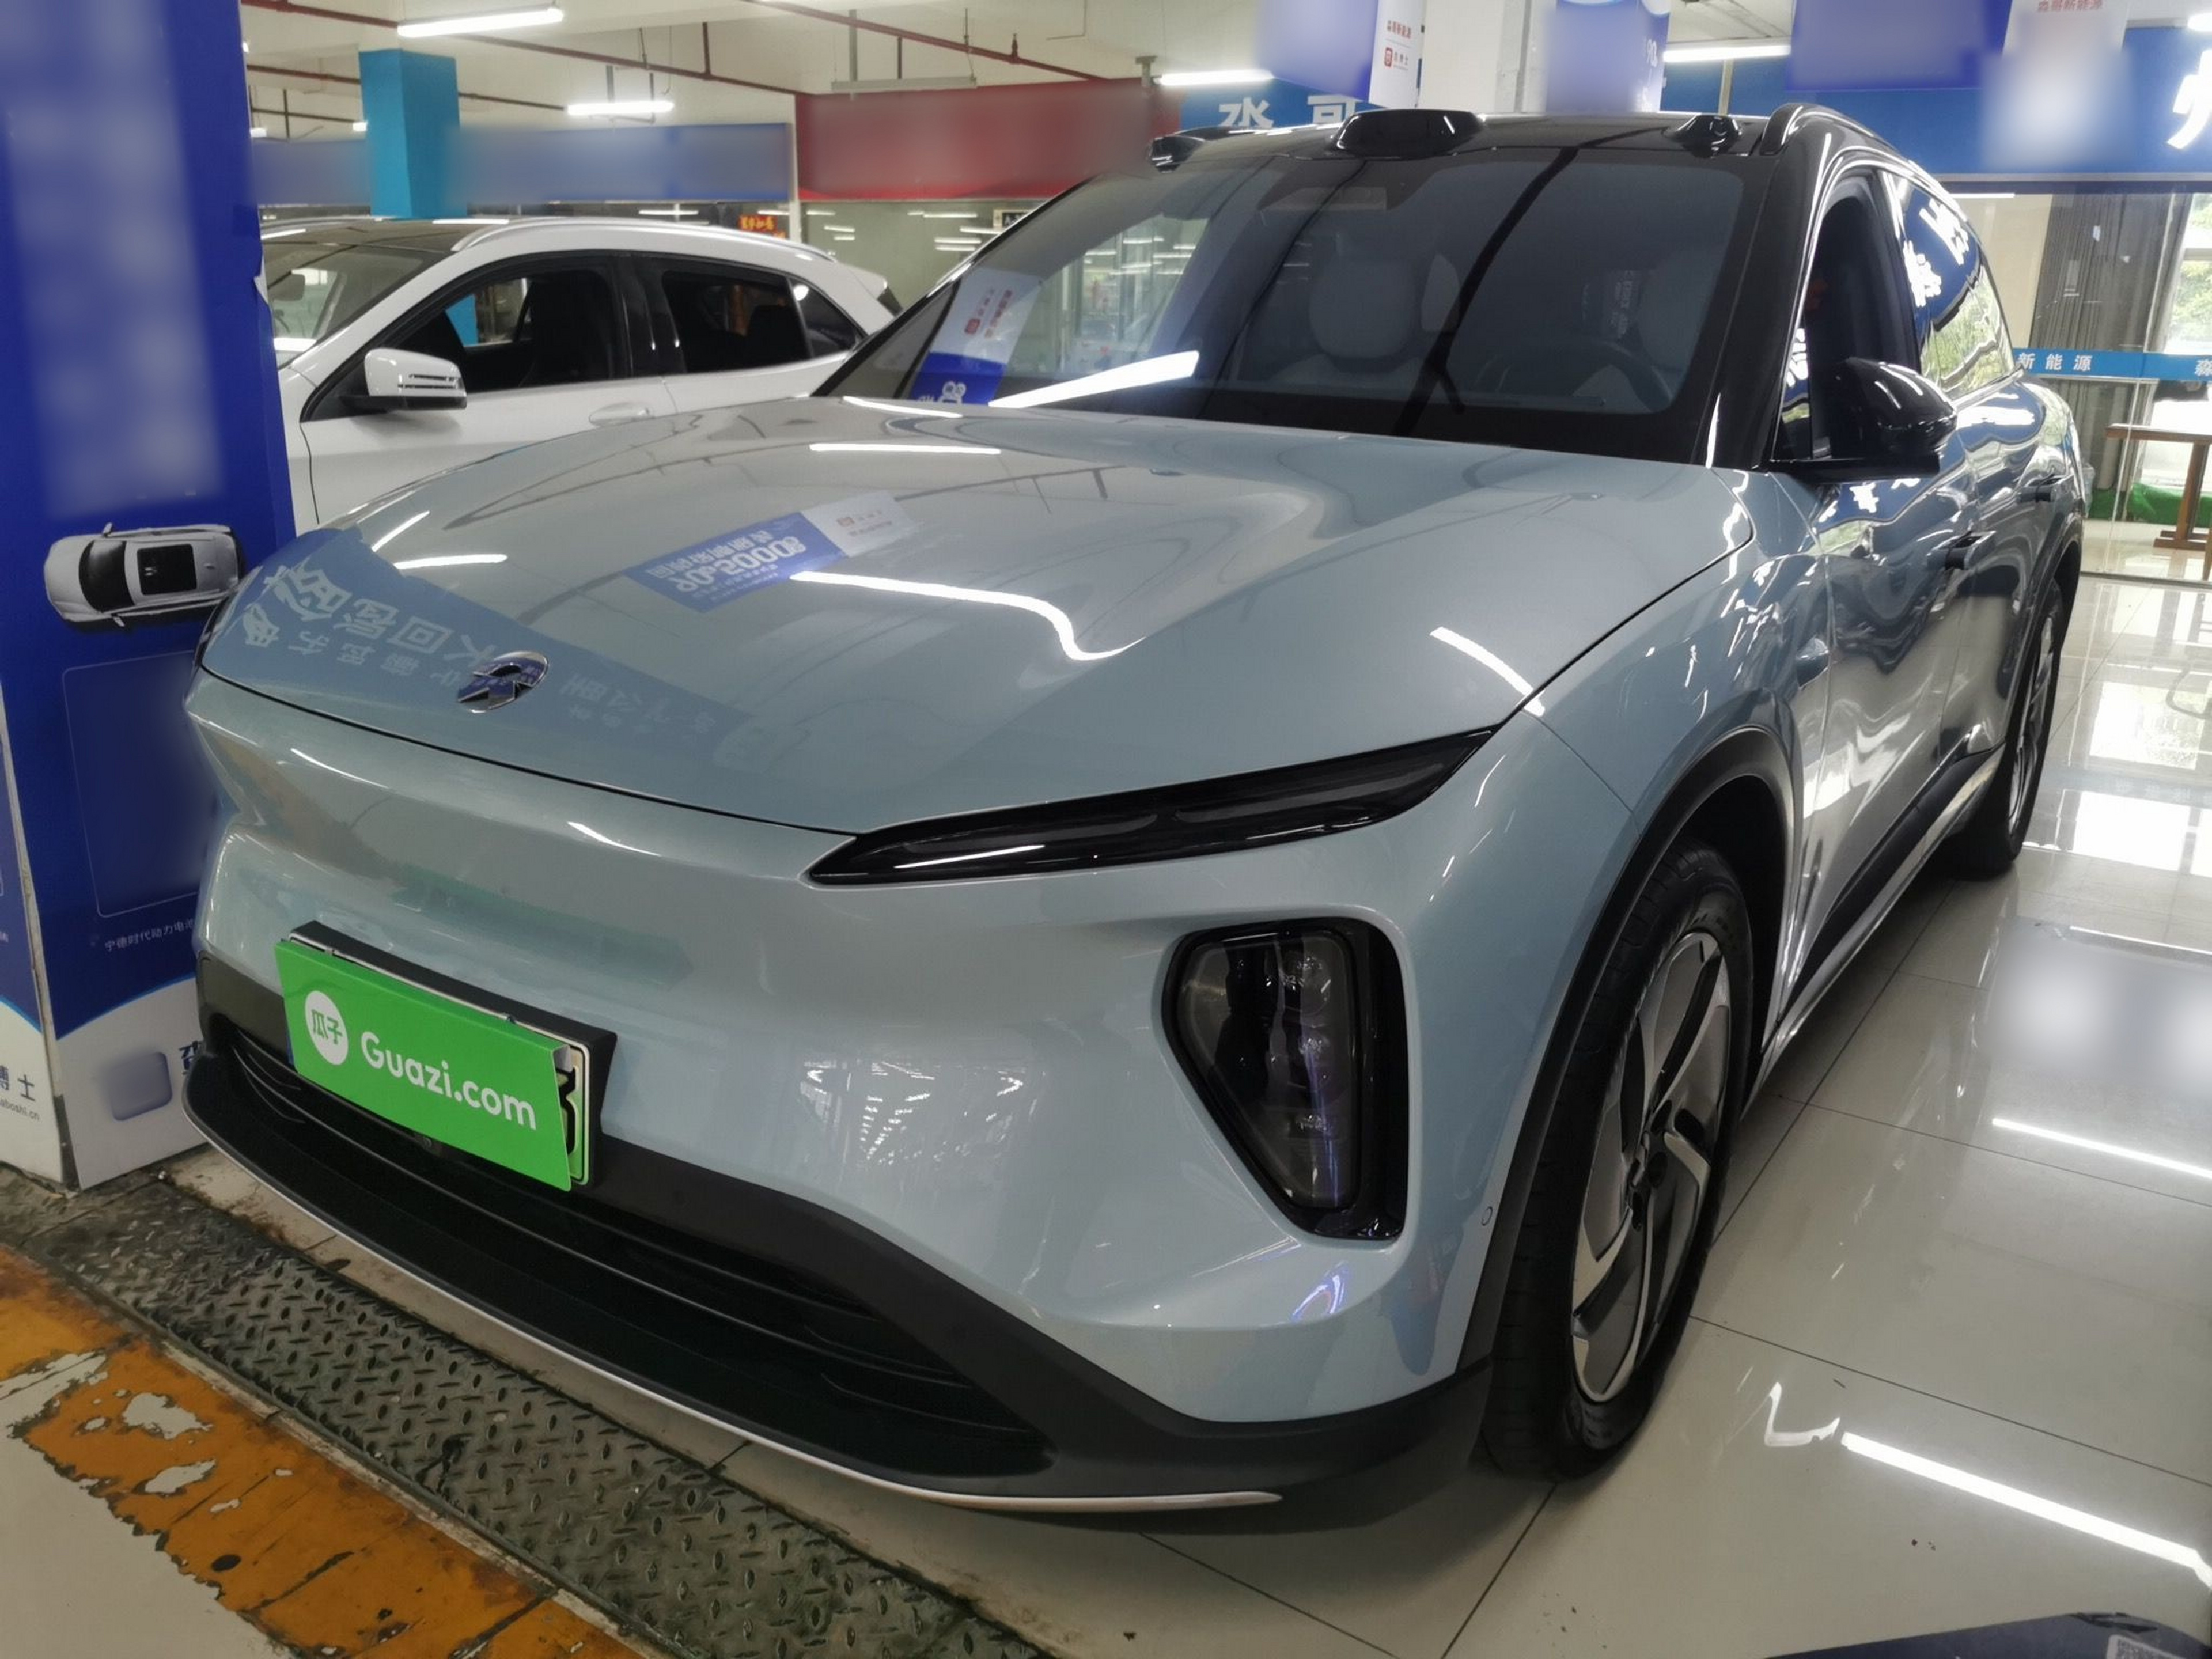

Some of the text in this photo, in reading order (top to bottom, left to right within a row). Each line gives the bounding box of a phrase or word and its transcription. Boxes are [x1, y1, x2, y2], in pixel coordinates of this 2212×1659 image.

[2017, 353, 2092, 372] 新能源
[311, 1007, 343, 1046] 瓜子
[360, 1031, 537, 1131] Guazi.com
